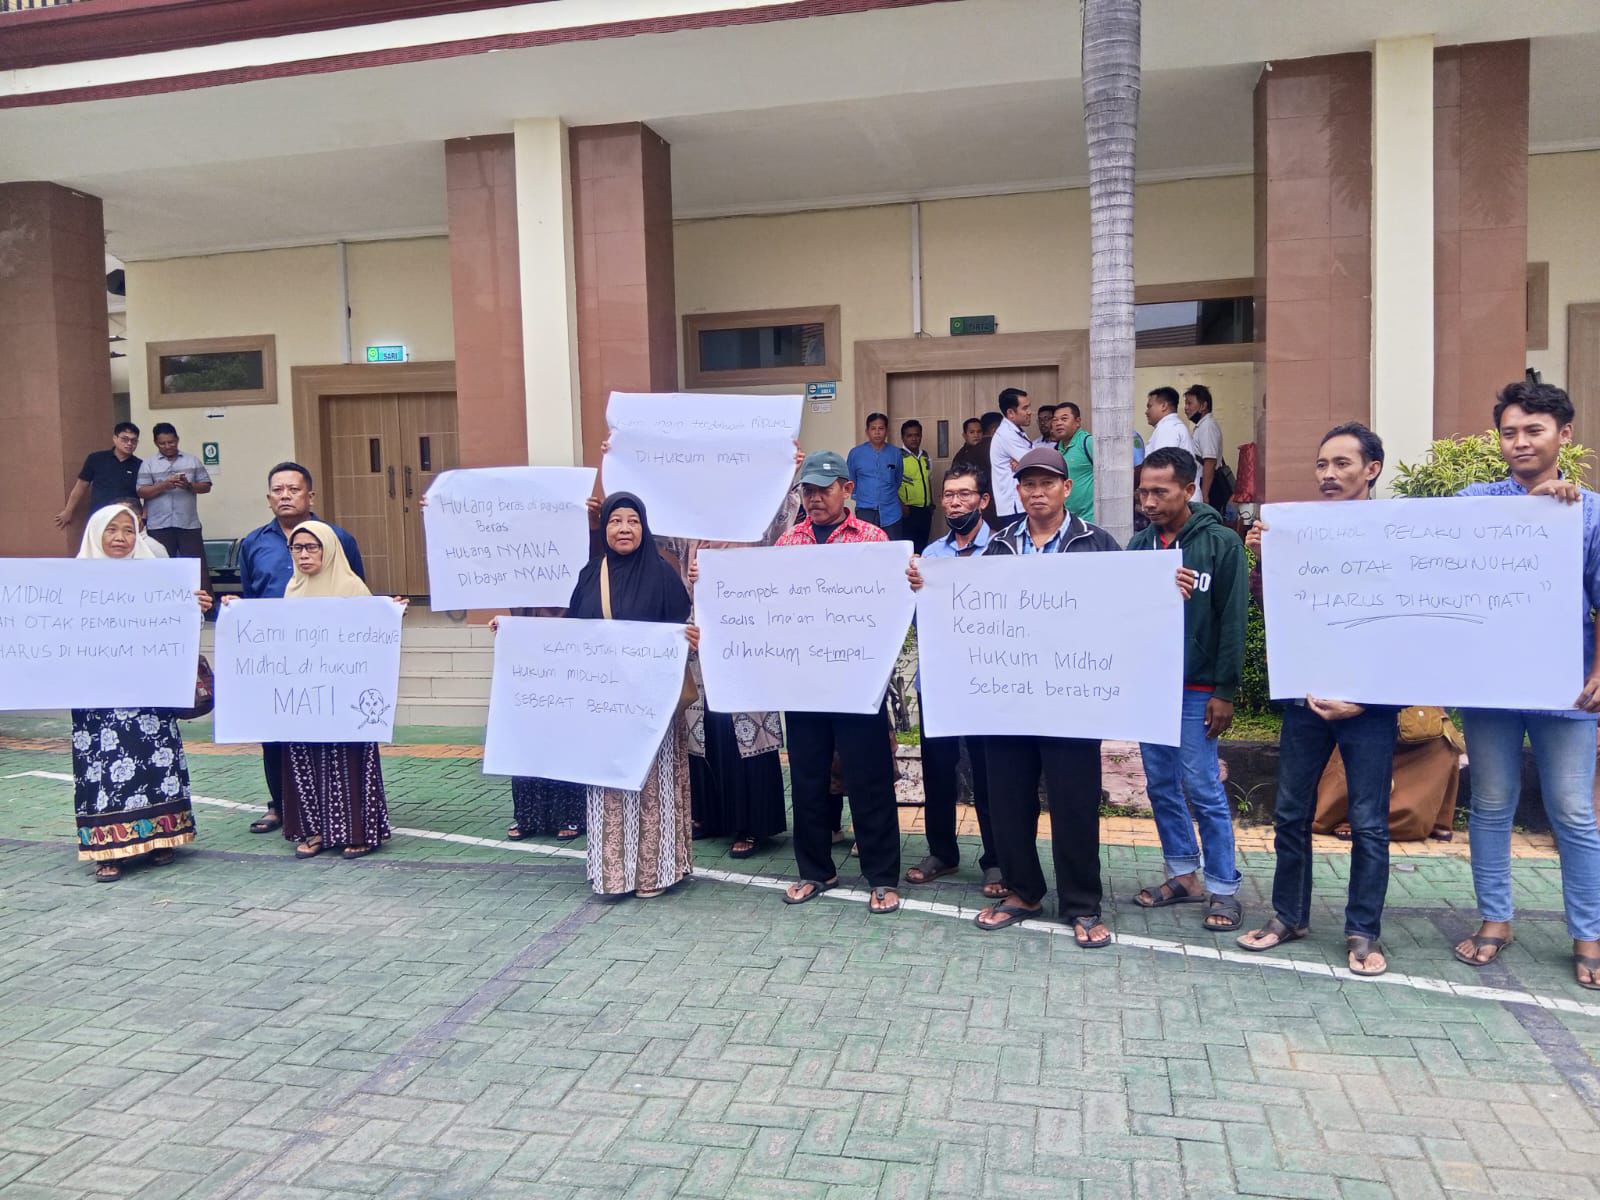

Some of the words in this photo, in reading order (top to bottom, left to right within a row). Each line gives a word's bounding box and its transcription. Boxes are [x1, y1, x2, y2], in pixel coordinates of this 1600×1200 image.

[717, 452, 751, 465] MATI
[476, 520, 509, 533] Beras
[1384, 524, 1461, 539] PELAKU
[1474, 525, 1549, 539] UTAMA
[497, 541, 560, 560] NYAWA
[514, 564, 571, 583] NYAWA
[1298, 561, 1329, 575] dan
[1341, 560, 1393, 575] OTAK
[1409, 555, 1540, 571] PEMBUNUHAN
[80, 590, 135, 608] PELAKU
[144, 589, 192, 604] UTAMA
[717, 581, 779, 603] Perampok
[789, 584, 811, 595] dan
[816, 578, 886, 595] Pembunuh
[952, 582, 1007, 611] Kami
[25, 616, 73, 630] OTAK
[81, 616, 181, 631] PEMBUNUHAN
[825, 608, 876, 628] harus
[236, 619, 285, 644] Kami
[295, 624, 329, 648] ingin
[338, 626, 399, 644] terdakwa
[143, 643, 185, 657] MATI
[722, 641, 800, 665] dihukum
[298, 657, 313, 673] di
[320, 655, 368, 675] hukum
[1055, 651, 1113, 671] Midhol
[512, 664, 556, 678] HUKUM
[969, 677, 1034, 695] Seberat
[1046, 680, 1120, 700] beratnya
[274, 685, 335, 716] MATI
[513, 692, 575, 709] SEBERAT
